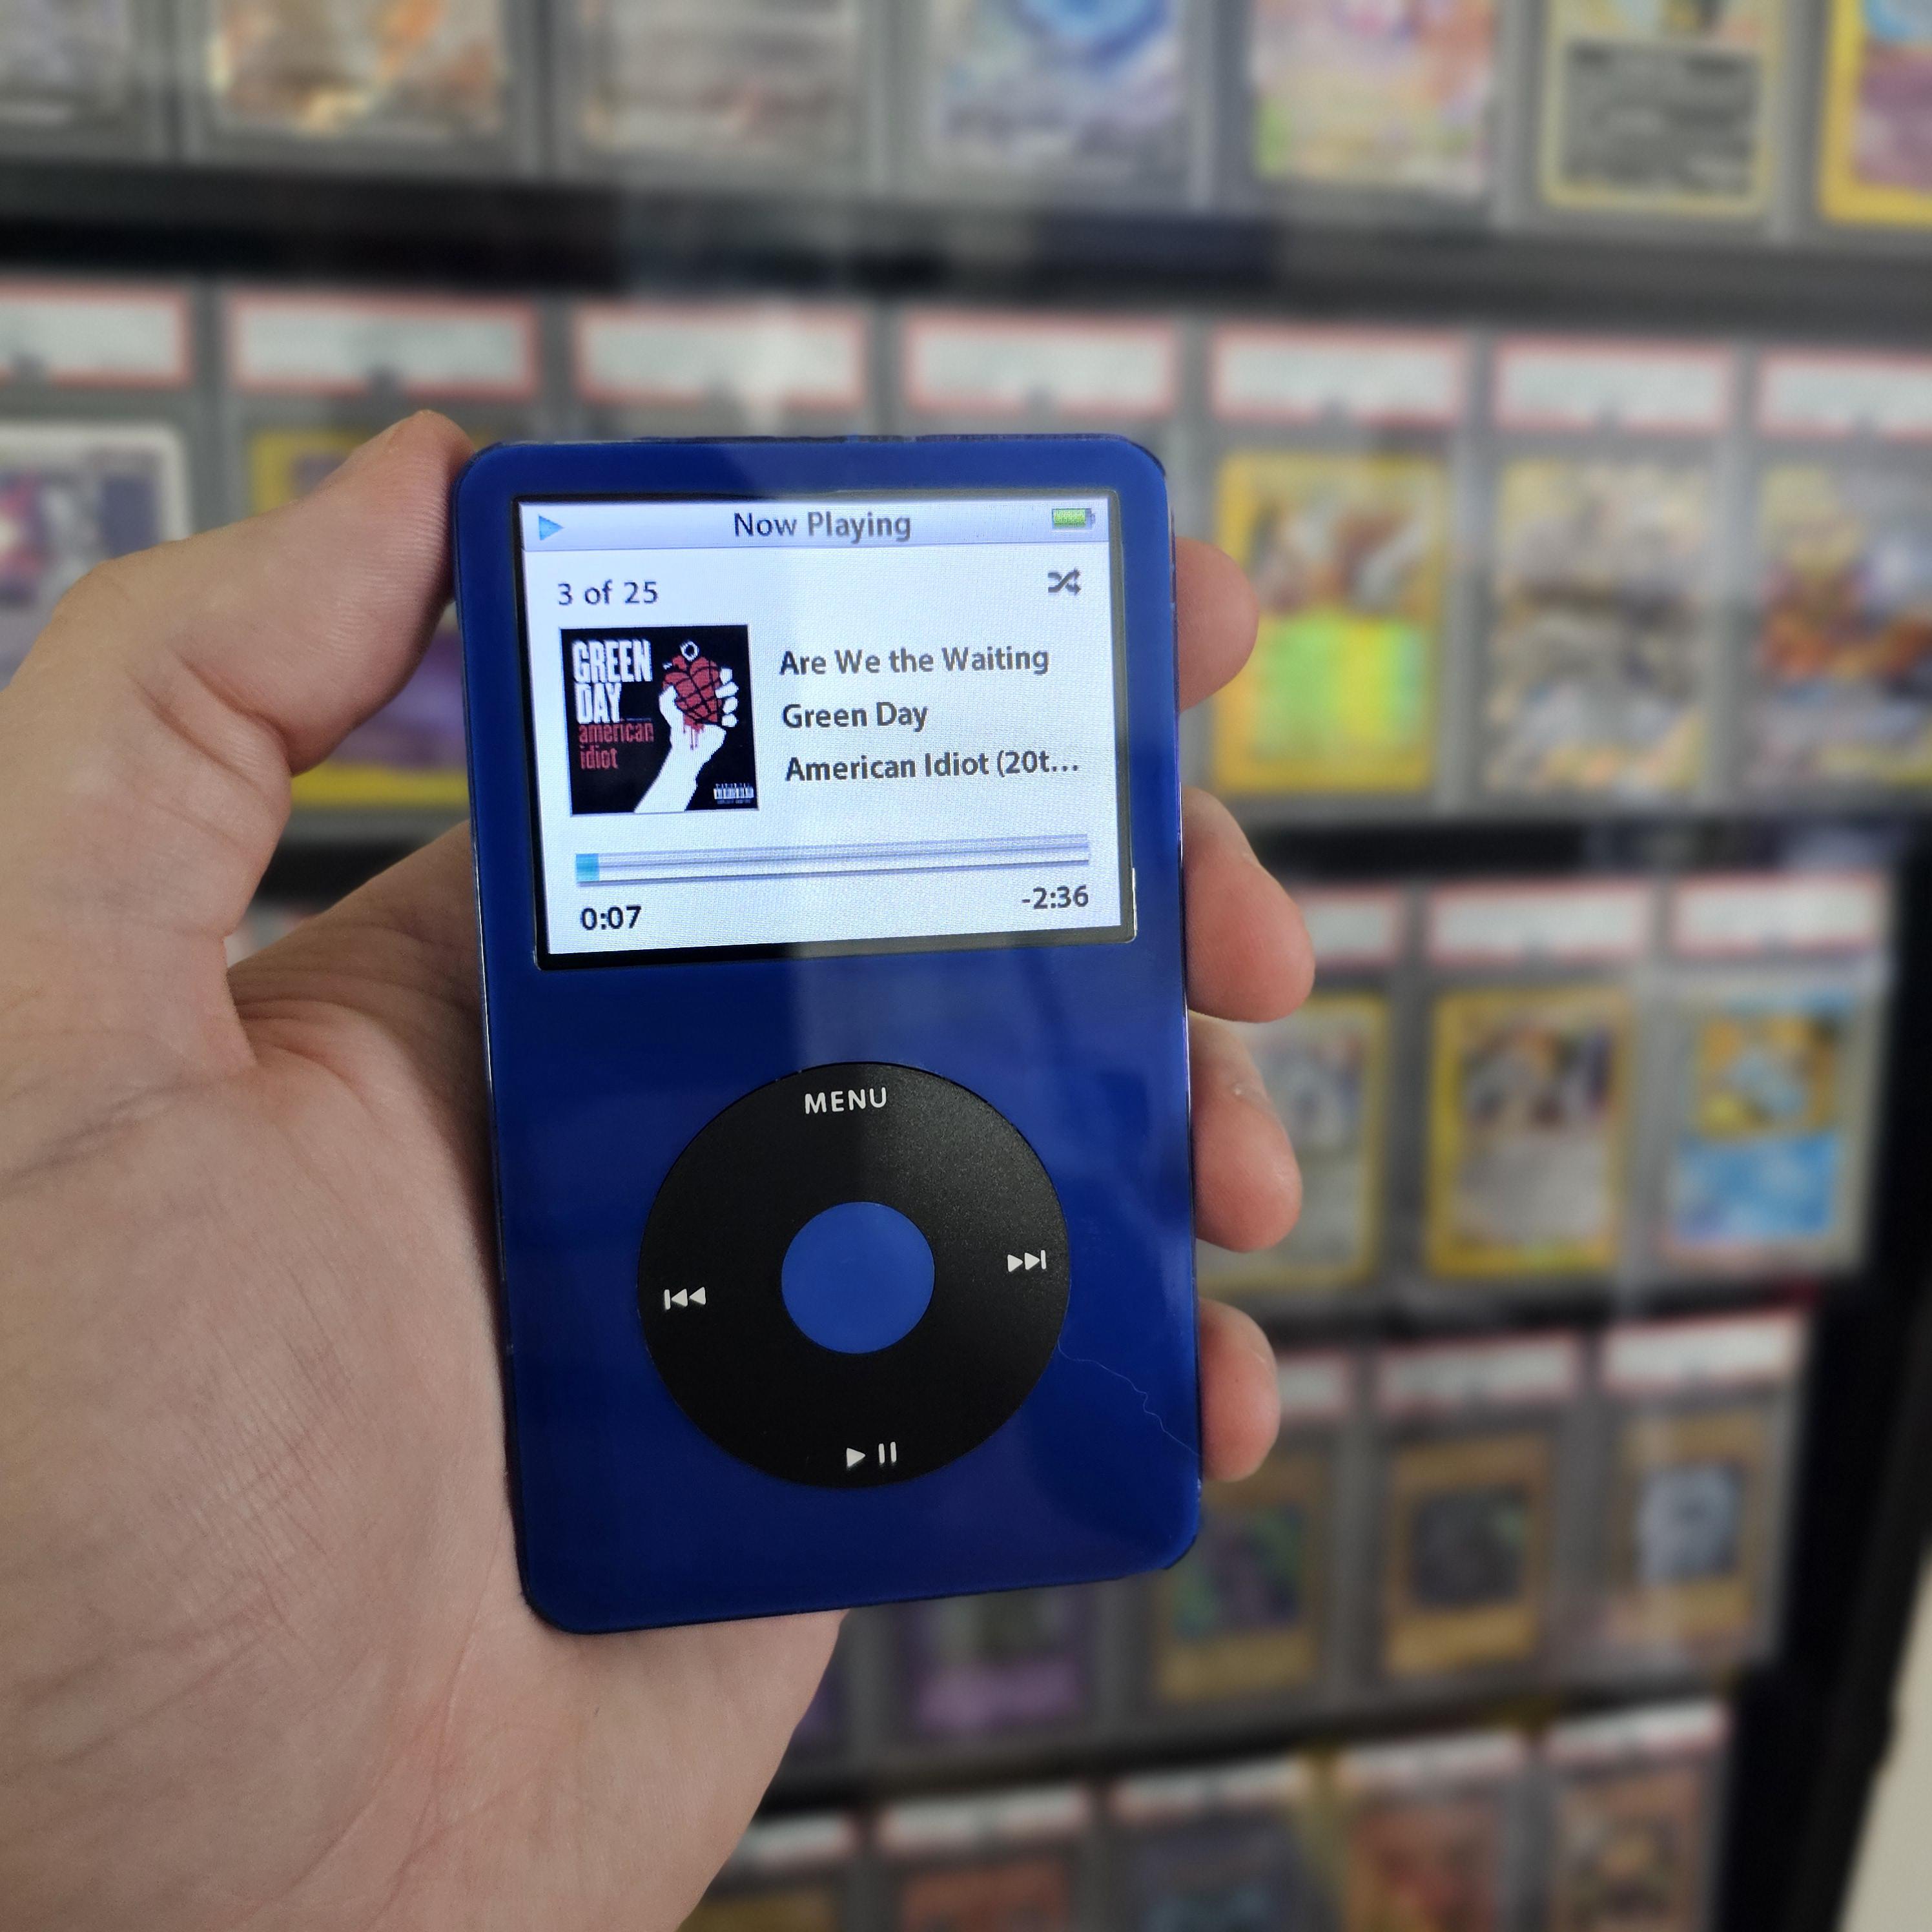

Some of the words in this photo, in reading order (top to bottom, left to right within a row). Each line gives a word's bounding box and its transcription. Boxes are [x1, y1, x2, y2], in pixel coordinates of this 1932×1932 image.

[734, 512, 797, 537] Now
[807, 511, 912, 544] Playing
[558, 583, 573, 606] 3
[584, 580, 613, 604] of
[624, 581, 659, 604] 25
[572, 639, 652, 683] GREEN
[780, 650, 827, 677] Are
[834, 650, 881, 674] We
[889, 647, 934, 673] the
[941, 646, 1049, 676] Waiting
[573, 683, 622, 724] DAY
[782, 704, 867, 730] Green
[876, 703, 929, 732] Day
[579, 720, 654, 743] american
[580, 743, 619, 768] idiot
[785, 755, 916, 782] American
[925, 752, 989, 778] Idiot
[1022, 885, 1090, 911] -2:36
[581, 905, 642, 931] 0:07
[805, 1087, 887, 1115] MENU
